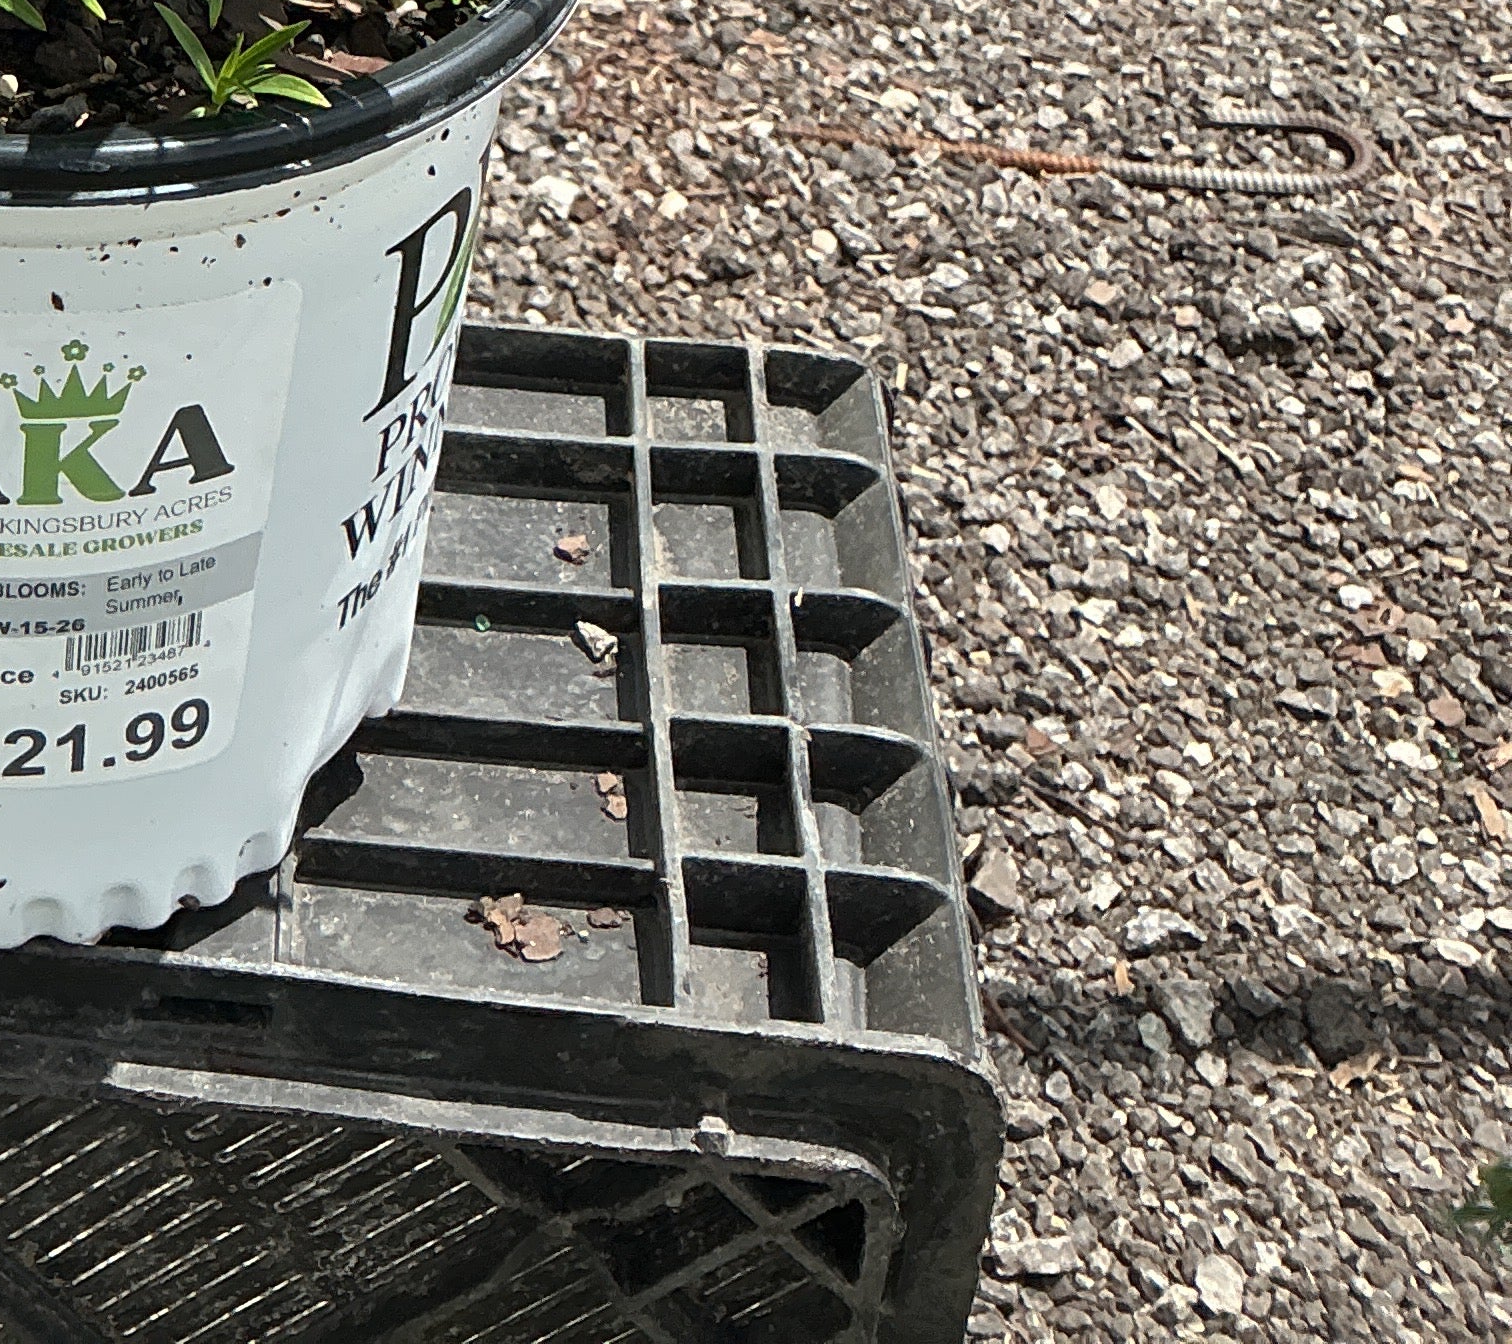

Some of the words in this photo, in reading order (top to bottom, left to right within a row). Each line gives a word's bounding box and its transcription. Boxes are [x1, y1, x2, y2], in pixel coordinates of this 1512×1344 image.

[371, 342, 453, 483] PRO
[153, 486, 234, 522] ACRES
[82, 519, 204, 555] GROWERS
[106, 571, 152, 594] Early
[158, 565, 174, 583] to
[180, 554, 217, 578] Late
[338, 568, 382, 630] The
[58, 685, 109, 705] SKU:
[124, 663, 200, 696] 2400565
